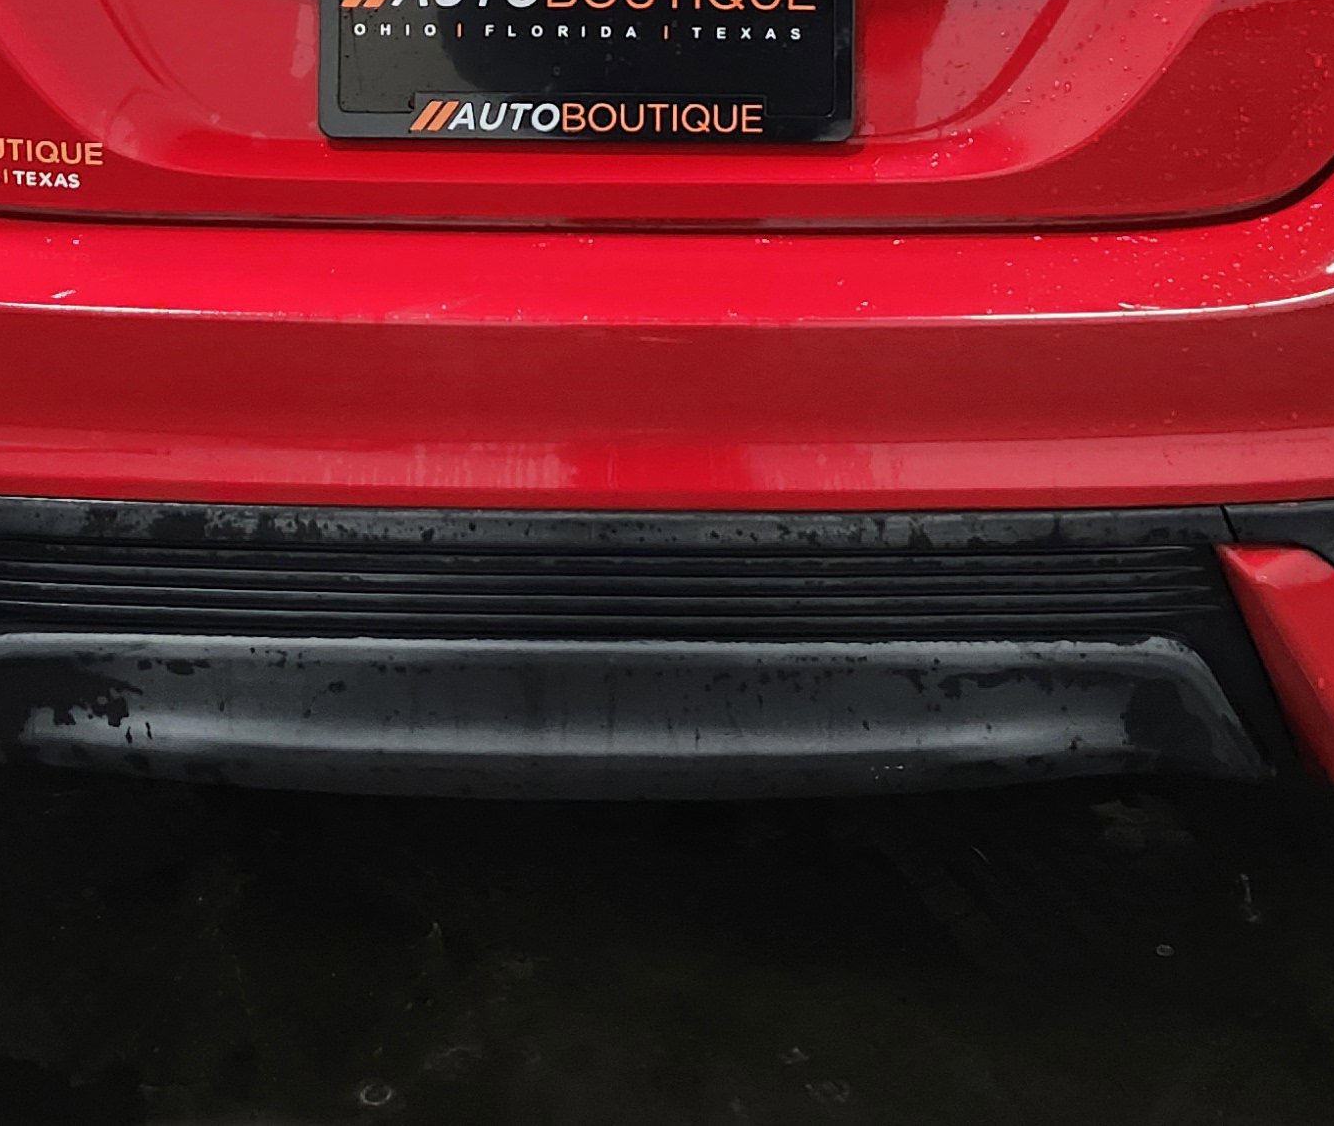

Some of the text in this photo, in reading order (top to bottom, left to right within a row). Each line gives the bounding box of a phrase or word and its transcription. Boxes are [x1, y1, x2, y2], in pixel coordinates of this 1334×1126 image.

[353, 23, 437, 37] OHIO
[484, 24, 637, 39] FLORIDA
[691, 26, 802, 40] TEXAS
[447, 100, 764, 134] AUTOBOUTIQUE
[13, 170, 81, 189] TEXAS
